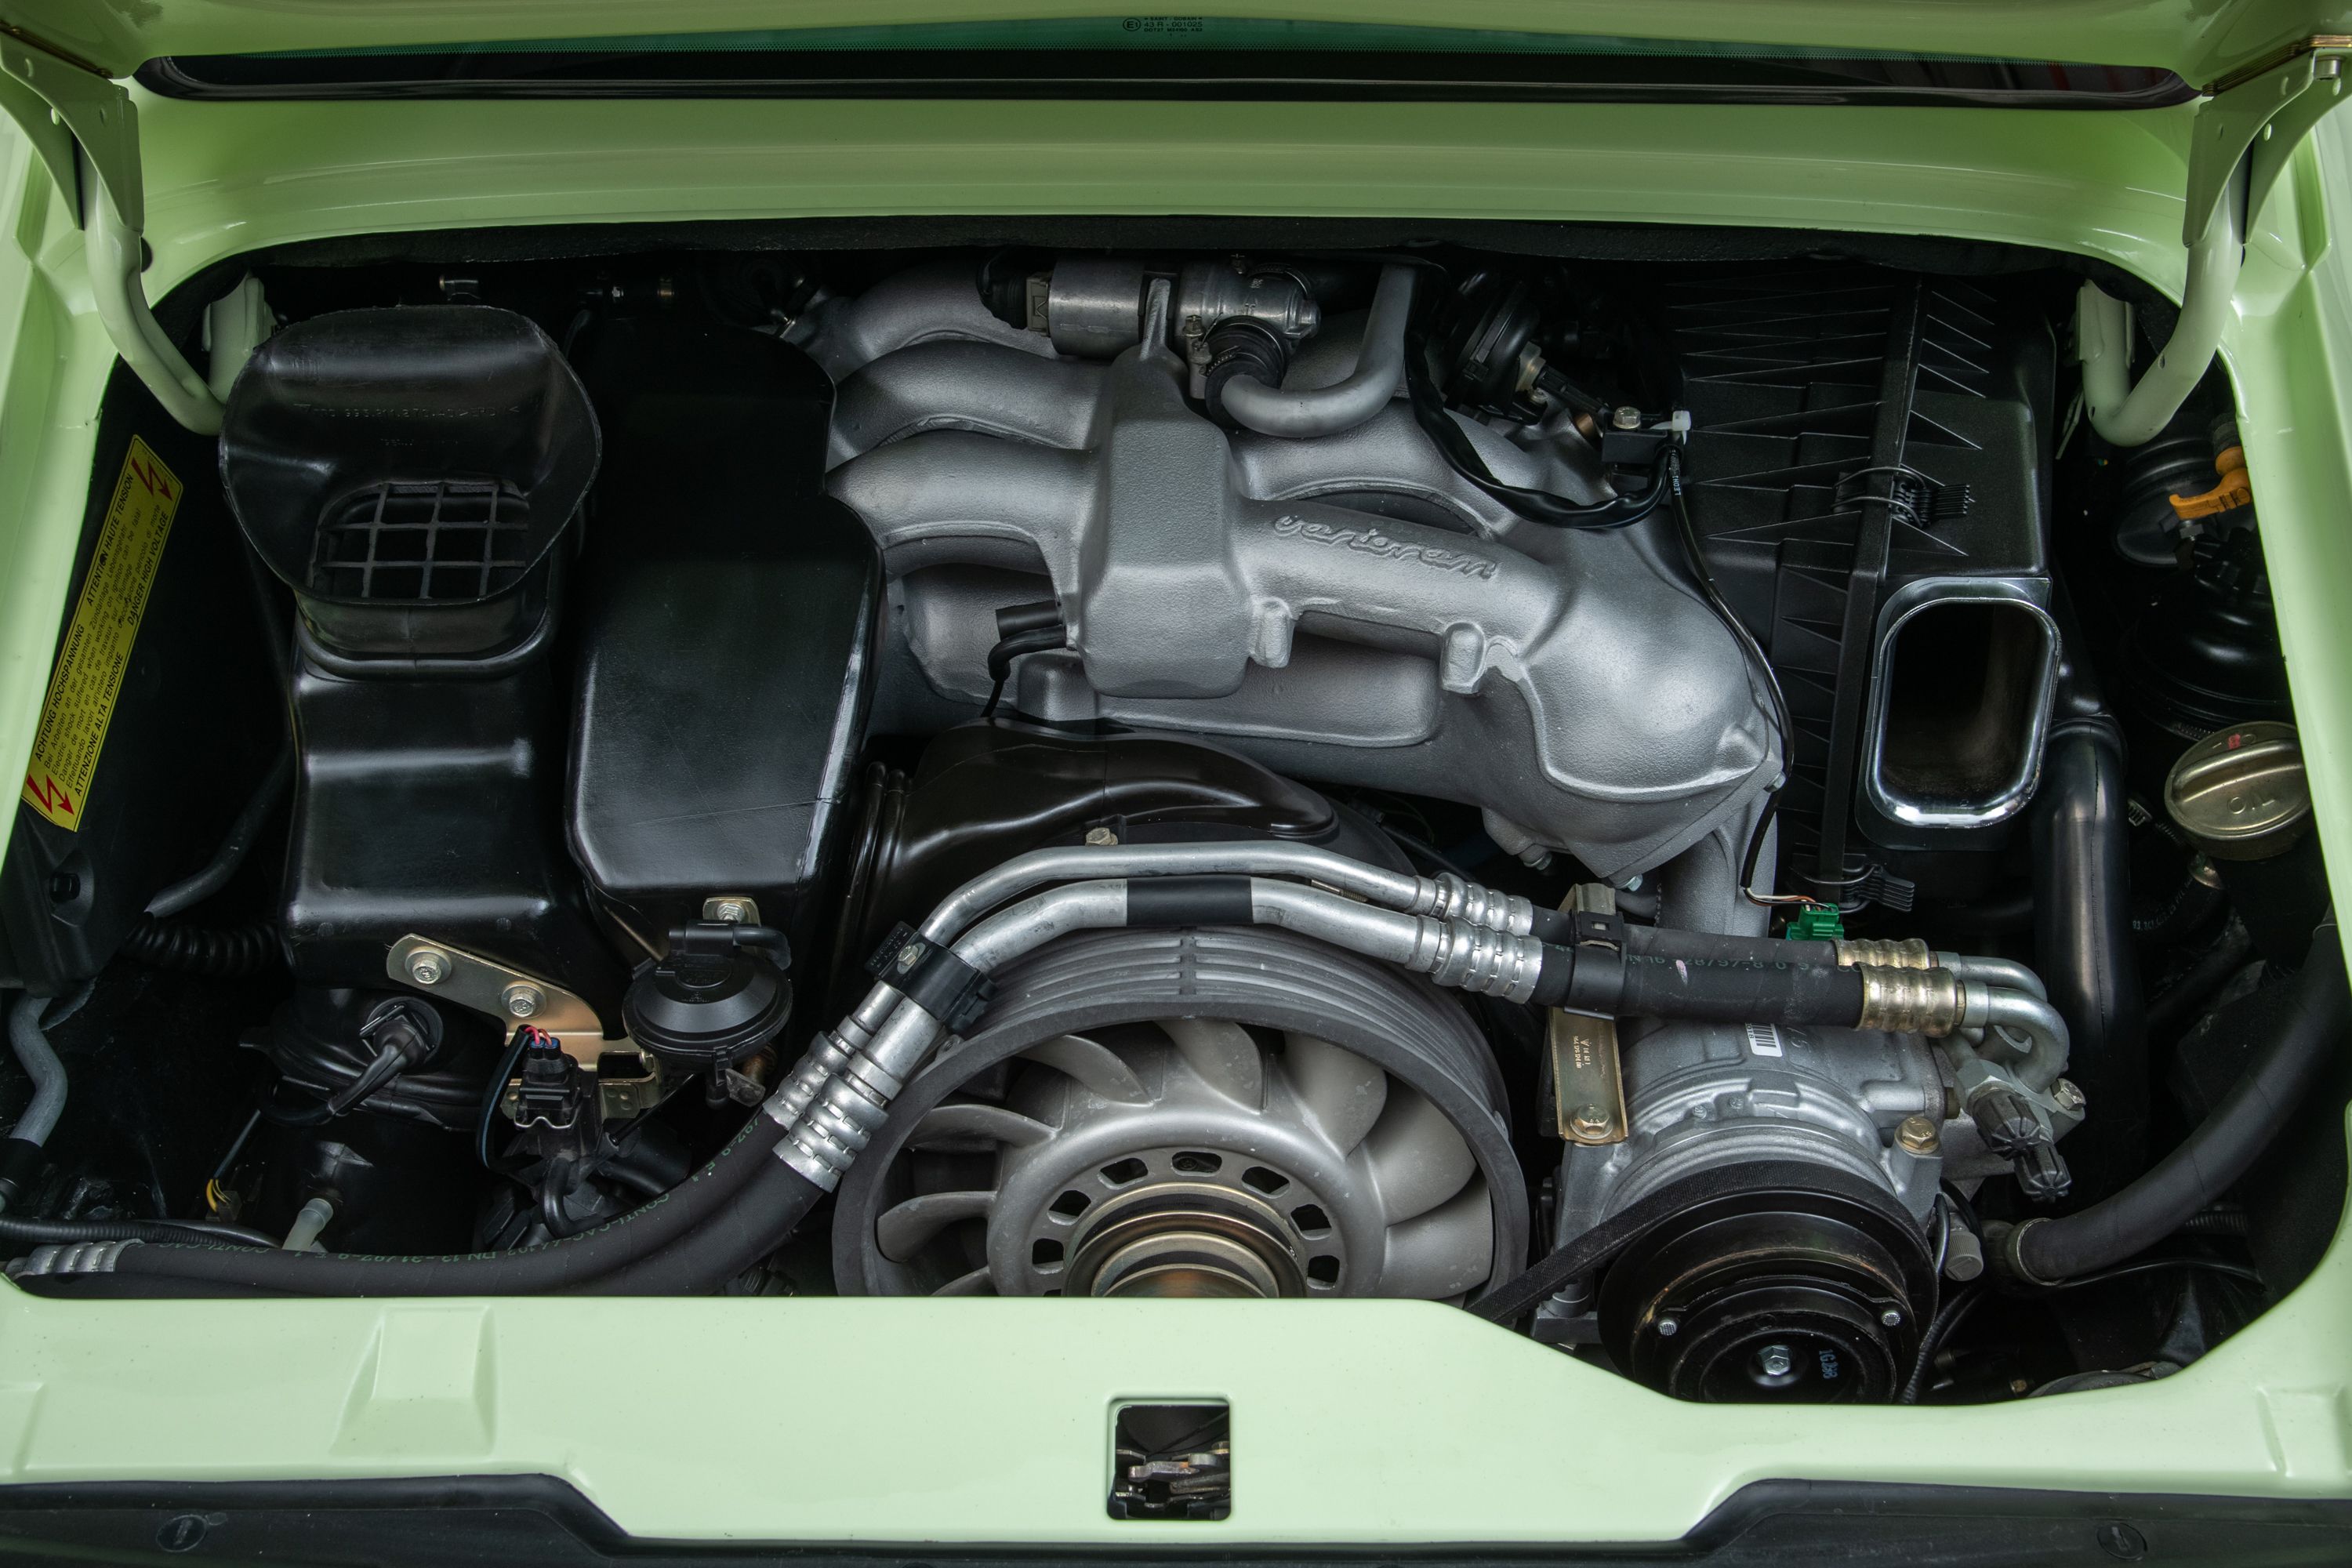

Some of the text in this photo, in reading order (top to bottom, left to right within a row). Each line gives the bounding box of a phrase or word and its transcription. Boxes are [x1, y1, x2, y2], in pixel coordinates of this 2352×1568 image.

[104, 514, 118, 551] HAUTE
[116, 471, 132, 516] TENSION
[1671, 475, 1682, 496] LEONI
[128, 510, 167, 626] DANGER HIGH VOLTAGE
[35, 622, 83, 761] ACHTUNG HOCHSPANNUNG
[45, 751, 53, 769] Bei
[50, 710, 66, 750] Arbeiten
[64, 695, 71, 710] an
[75, 631, 93, 676] gesamten
[51, 740, 66, 776] Electric
[63, 710, 75, 739] shock
[73, 670, 88, 709] suffered
[85, 644, 96, 670] when
[95, 609, 108, 644] working
[107, 594, 113, 608] on
[111, 561, 124, 594] ignition
[127, 528, 133, 542] be
[132, 506, 141, 528] fatal
[59, 748, 74, 783] Danger
[71, 732, 78, 746] de
[76, 708, 85, 731] mort
[84, 693, 90, 706] en
[94, 658, 101, 672] de
[100, 623, 112, 656] travaux
[66, 737, 85, 789] Effettuando
[83, 709, 94, 735] lavori
[92, 669, 107, 708] all'intero
[104, 630, 119, 668] impianto
[135, 539, 148, 575] pericolo
[150, 503, 160, 528] morte
[74, 651, 122, 797] ATTENZIONE ALTA TENSIONE
